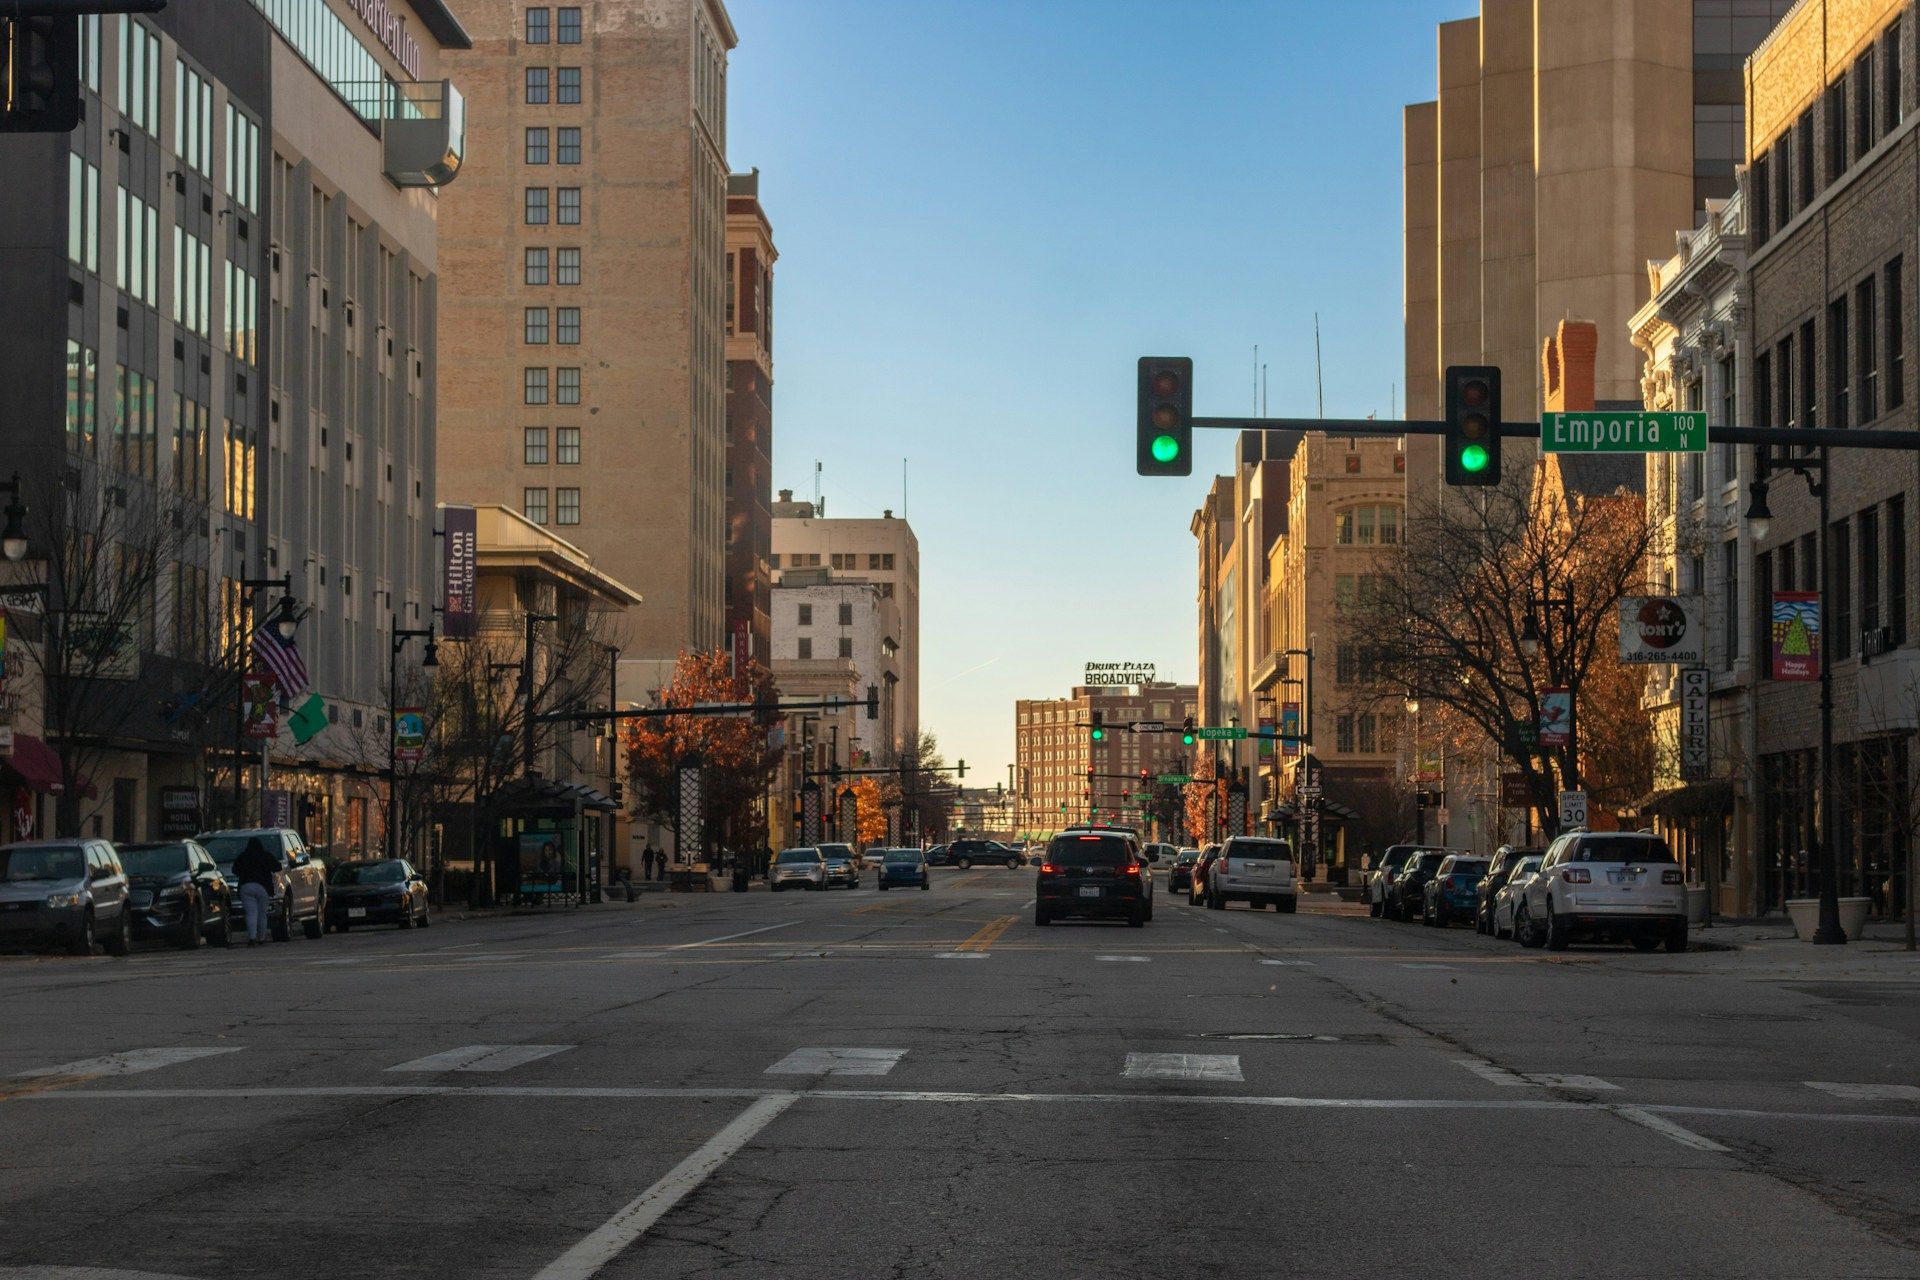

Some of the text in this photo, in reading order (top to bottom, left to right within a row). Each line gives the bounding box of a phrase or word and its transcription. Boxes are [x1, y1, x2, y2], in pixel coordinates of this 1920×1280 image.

[401, 16, 420, 81] Inn
[1673, 415, 1695, 431] 100
[1554, 413, 1660, 450] Emporia
[1679, 433, 1688, 449] N
[464, 531, 474, 558] Inn
[449, 531, 464, 595] Hilton
[1626, 651, 1697, 661] 316-265-4400
[1086, 662, 1155, 671] DRURY PLAZA
[1785, 661, 1807, 670] Happy
[1085, 673, 1155, 684] BROADVIEW
[1781, 668, 1809, 677] Holidays
[1686, 673, 1705, 761] GALLERY
[1201, 728, 1233, 739] Topeka
[170, 812, 191, 822] HOTEL
[1563, 809, 1585, 822] 30
[163, 823, 196, 831] ENTRANCE
